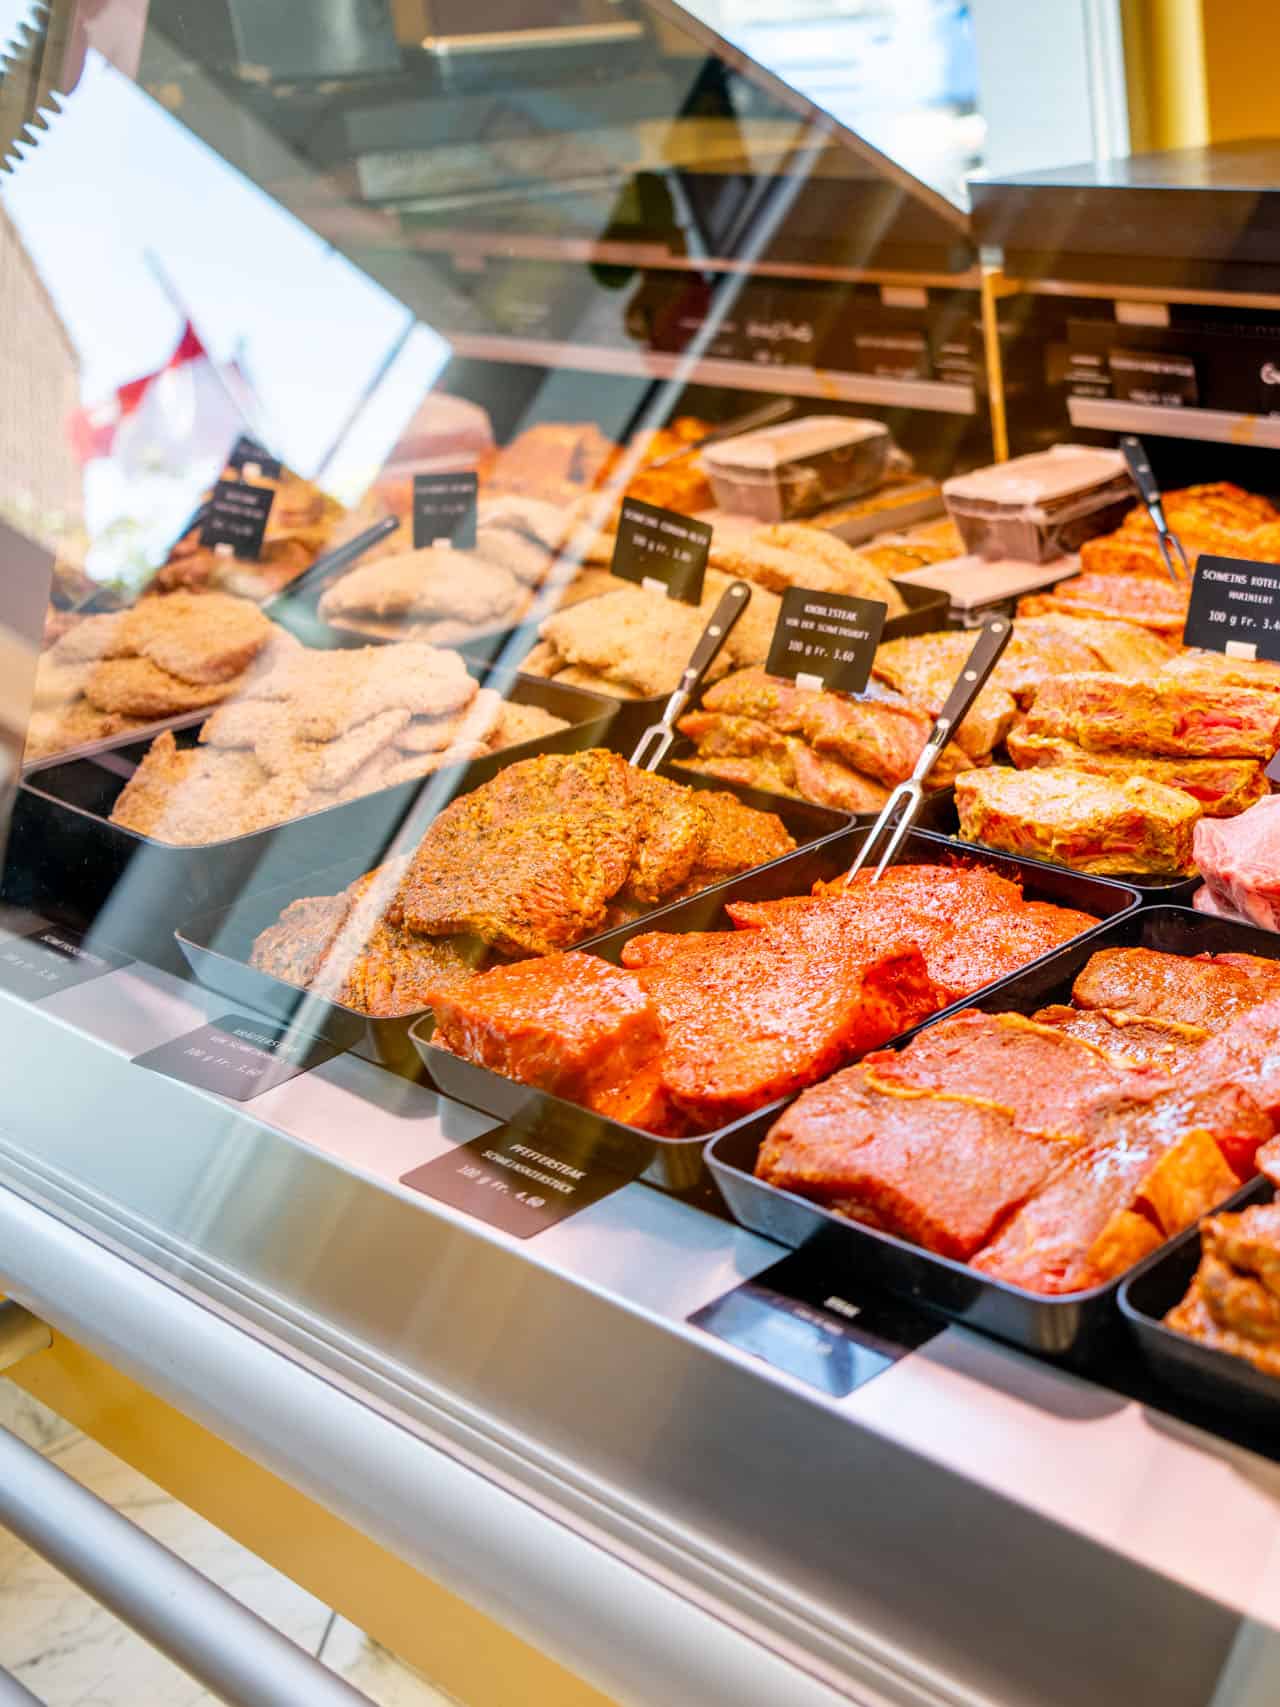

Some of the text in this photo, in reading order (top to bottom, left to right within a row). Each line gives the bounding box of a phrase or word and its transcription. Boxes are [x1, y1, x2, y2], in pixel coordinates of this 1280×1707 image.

[1201, 568, 1248, 585] SCHWEINS
[1208, 610, 1227, 623] 100
[1229, 615, 1238, 627] g
[1240, 616, 1257, 628] Fr.
[509, 1143, 588, 1180] PFEFFERSTEAK
[457, 1164, 482, 1179] 100
